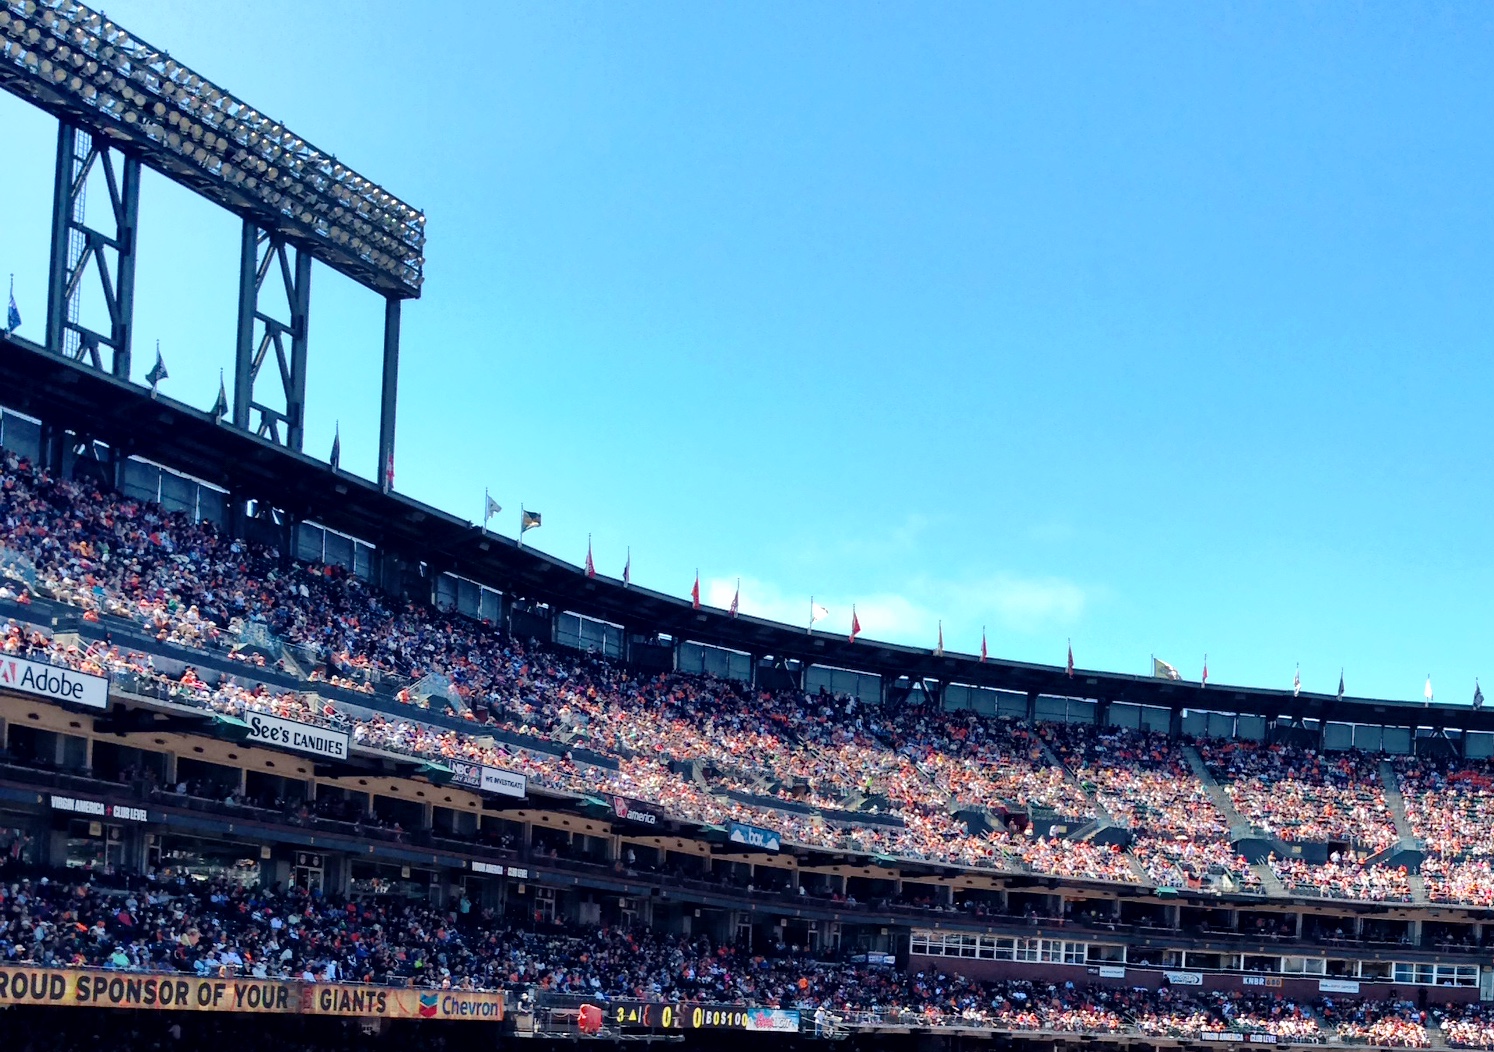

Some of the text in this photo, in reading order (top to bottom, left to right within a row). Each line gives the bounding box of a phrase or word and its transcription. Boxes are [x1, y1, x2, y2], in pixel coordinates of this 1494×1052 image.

[21, 666, 84, 699] Adobe
[250, 717, 343, 755] See's CANDIES
[452, 761, 470, 776] NBC
[51, 796, 147, 822] VIRGIN AMERICA CLUB LEVEL
[626, 810, 656, 825] america
[749, 829, 765, 847] box
[1242, 977, 1265, 986] KNBR
[75, 975, 189, 1005] SPONSOR
[197, 983, 227, 1006] OF
[234, 984, 289, 1009] YOUR
[320, 988, 387, 1013] GIANTS
[442, 996, 498, 1017] Chevron
